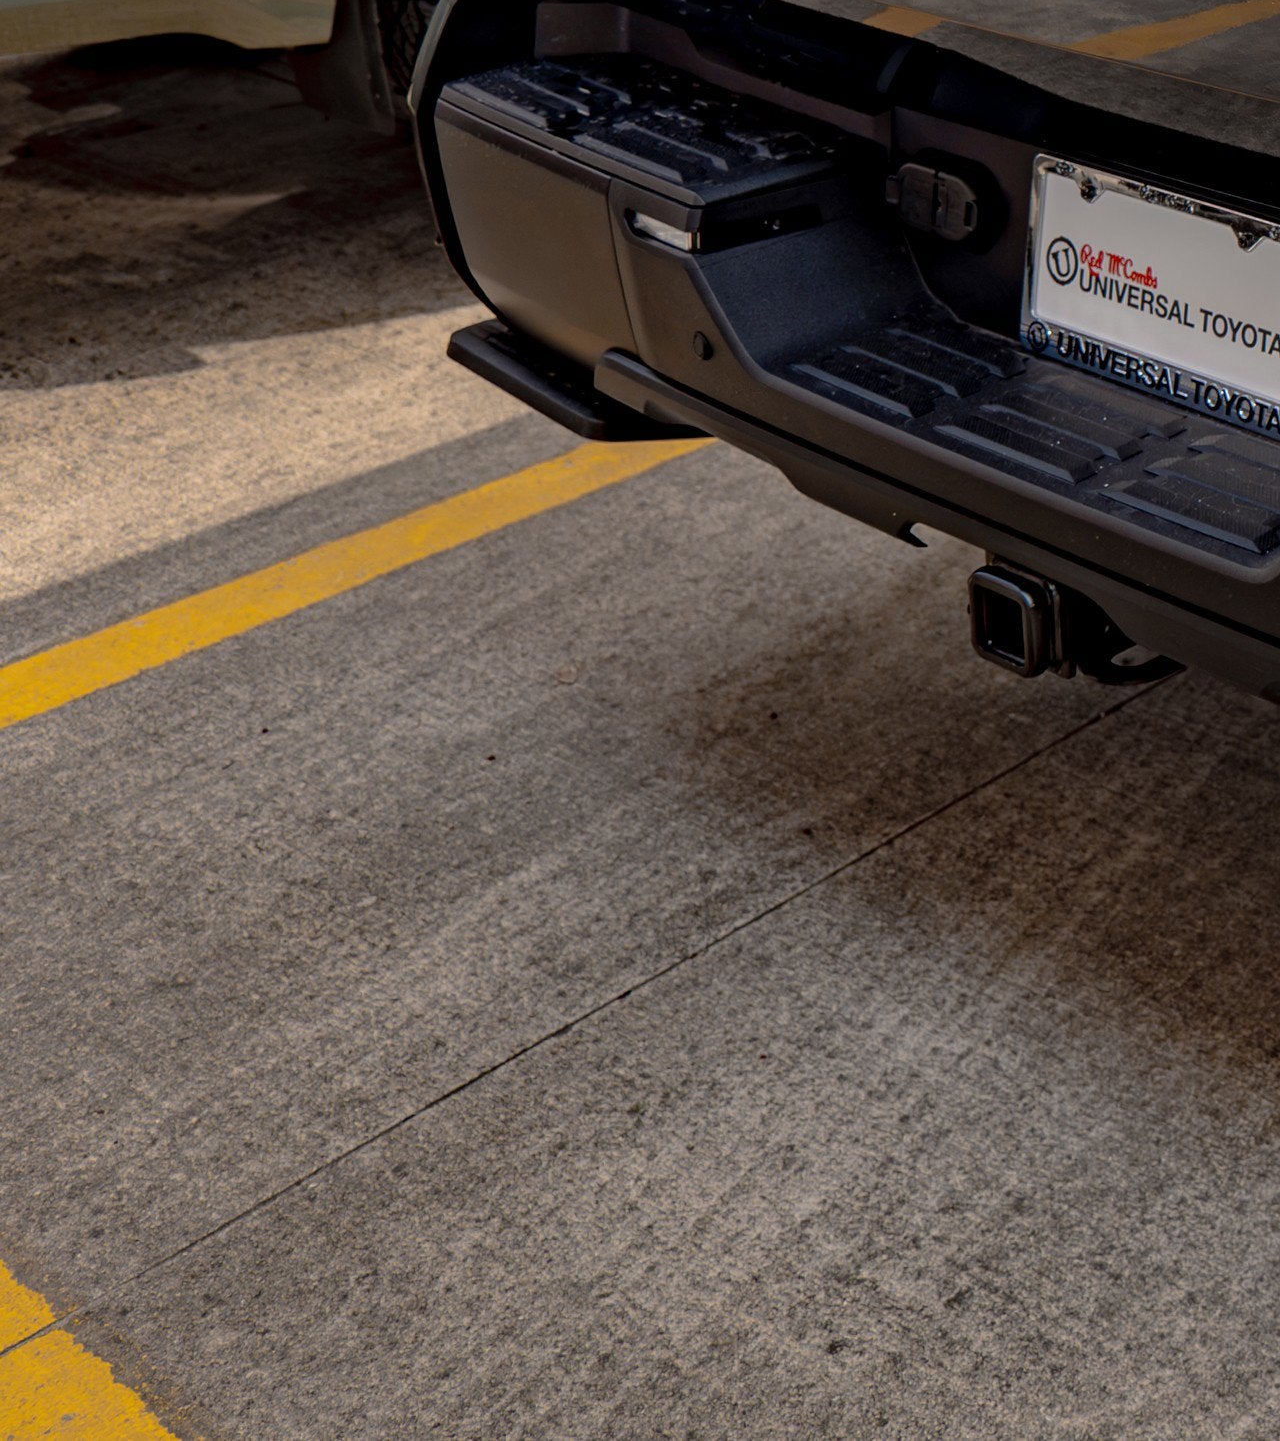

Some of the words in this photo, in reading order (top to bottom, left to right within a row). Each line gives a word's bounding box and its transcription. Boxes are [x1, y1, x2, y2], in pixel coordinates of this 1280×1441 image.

[1079, 268, 1195, 329] UNIVERSAL
[1105, 252, 1157, 290] McCombs
[1056, 330, 1189, 399] UNIVERSAL
